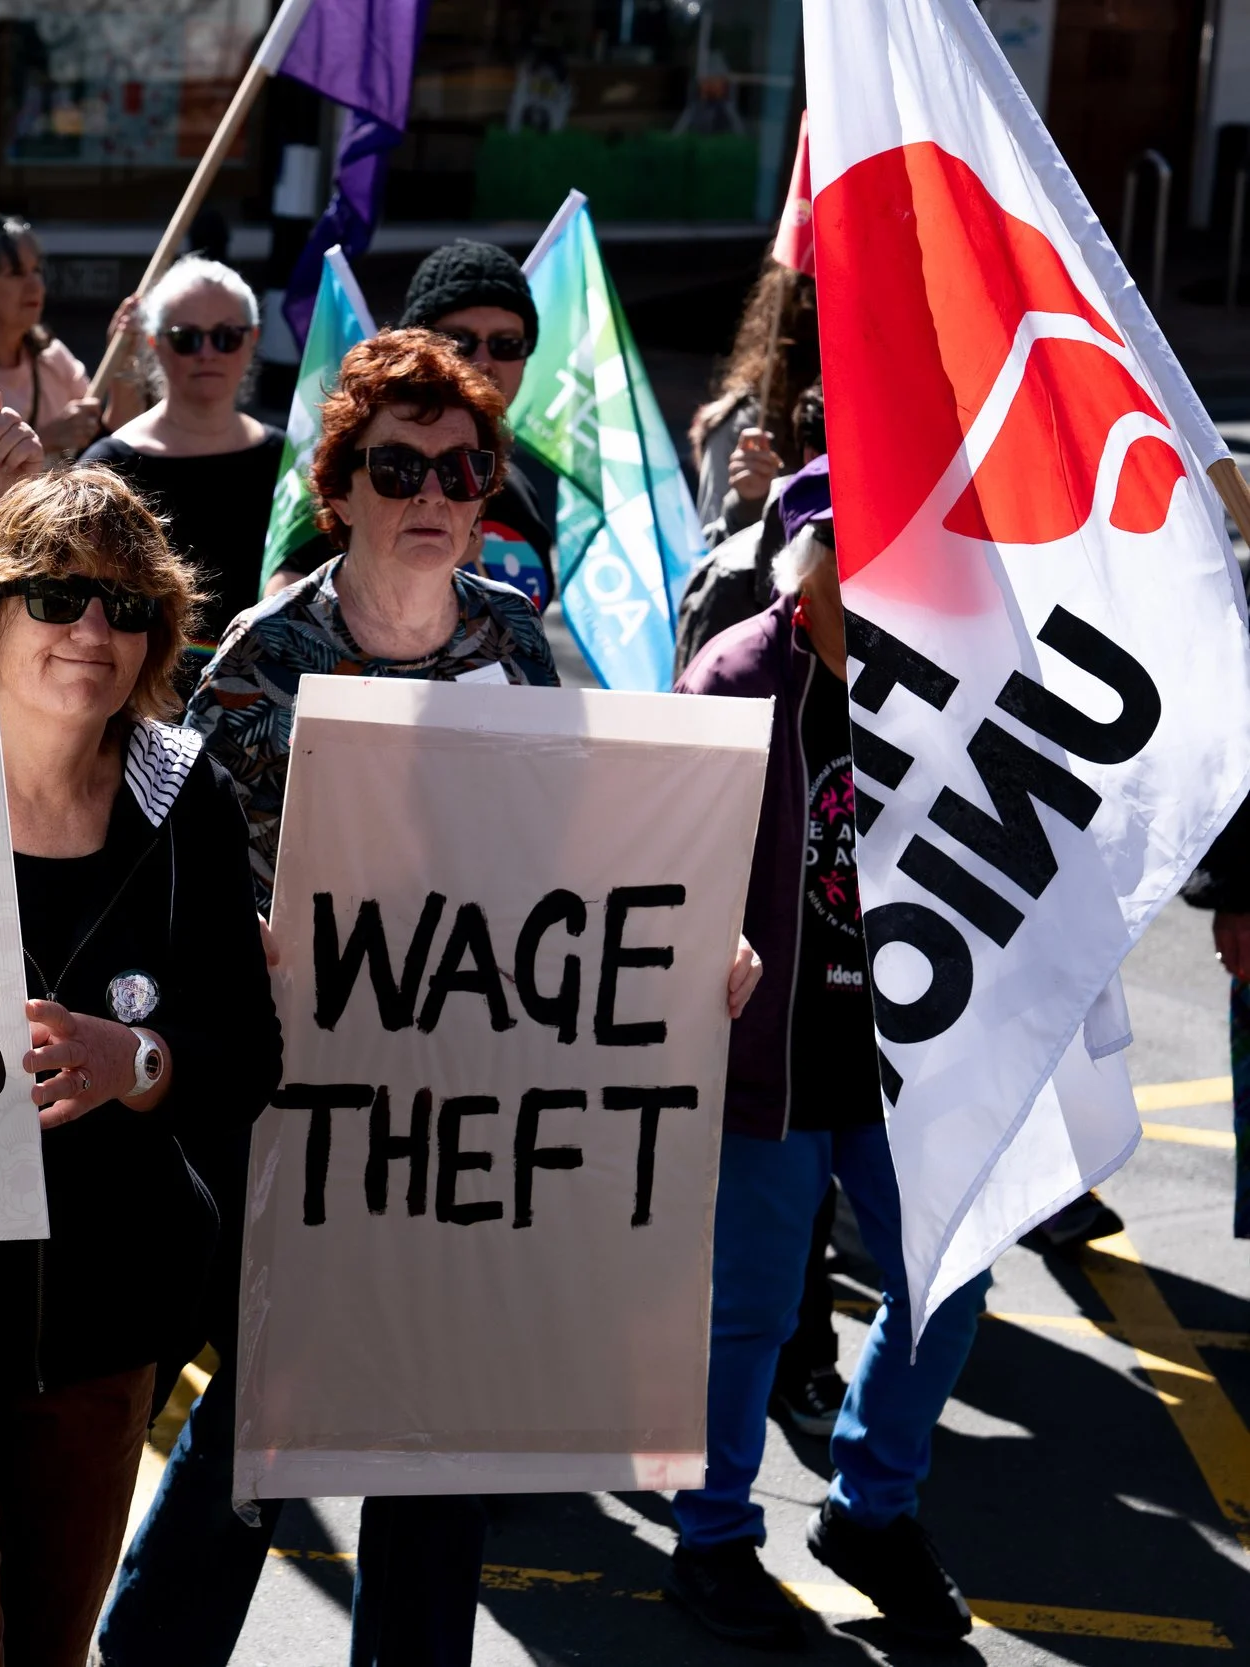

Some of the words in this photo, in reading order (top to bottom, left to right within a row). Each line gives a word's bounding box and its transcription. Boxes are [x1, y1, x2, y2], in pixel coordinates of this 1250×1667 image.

[312, 883, 687, 1046] WAGE
[826, 963, 863, 985] idea
[270, 1082, 699, 1230] THEFT
